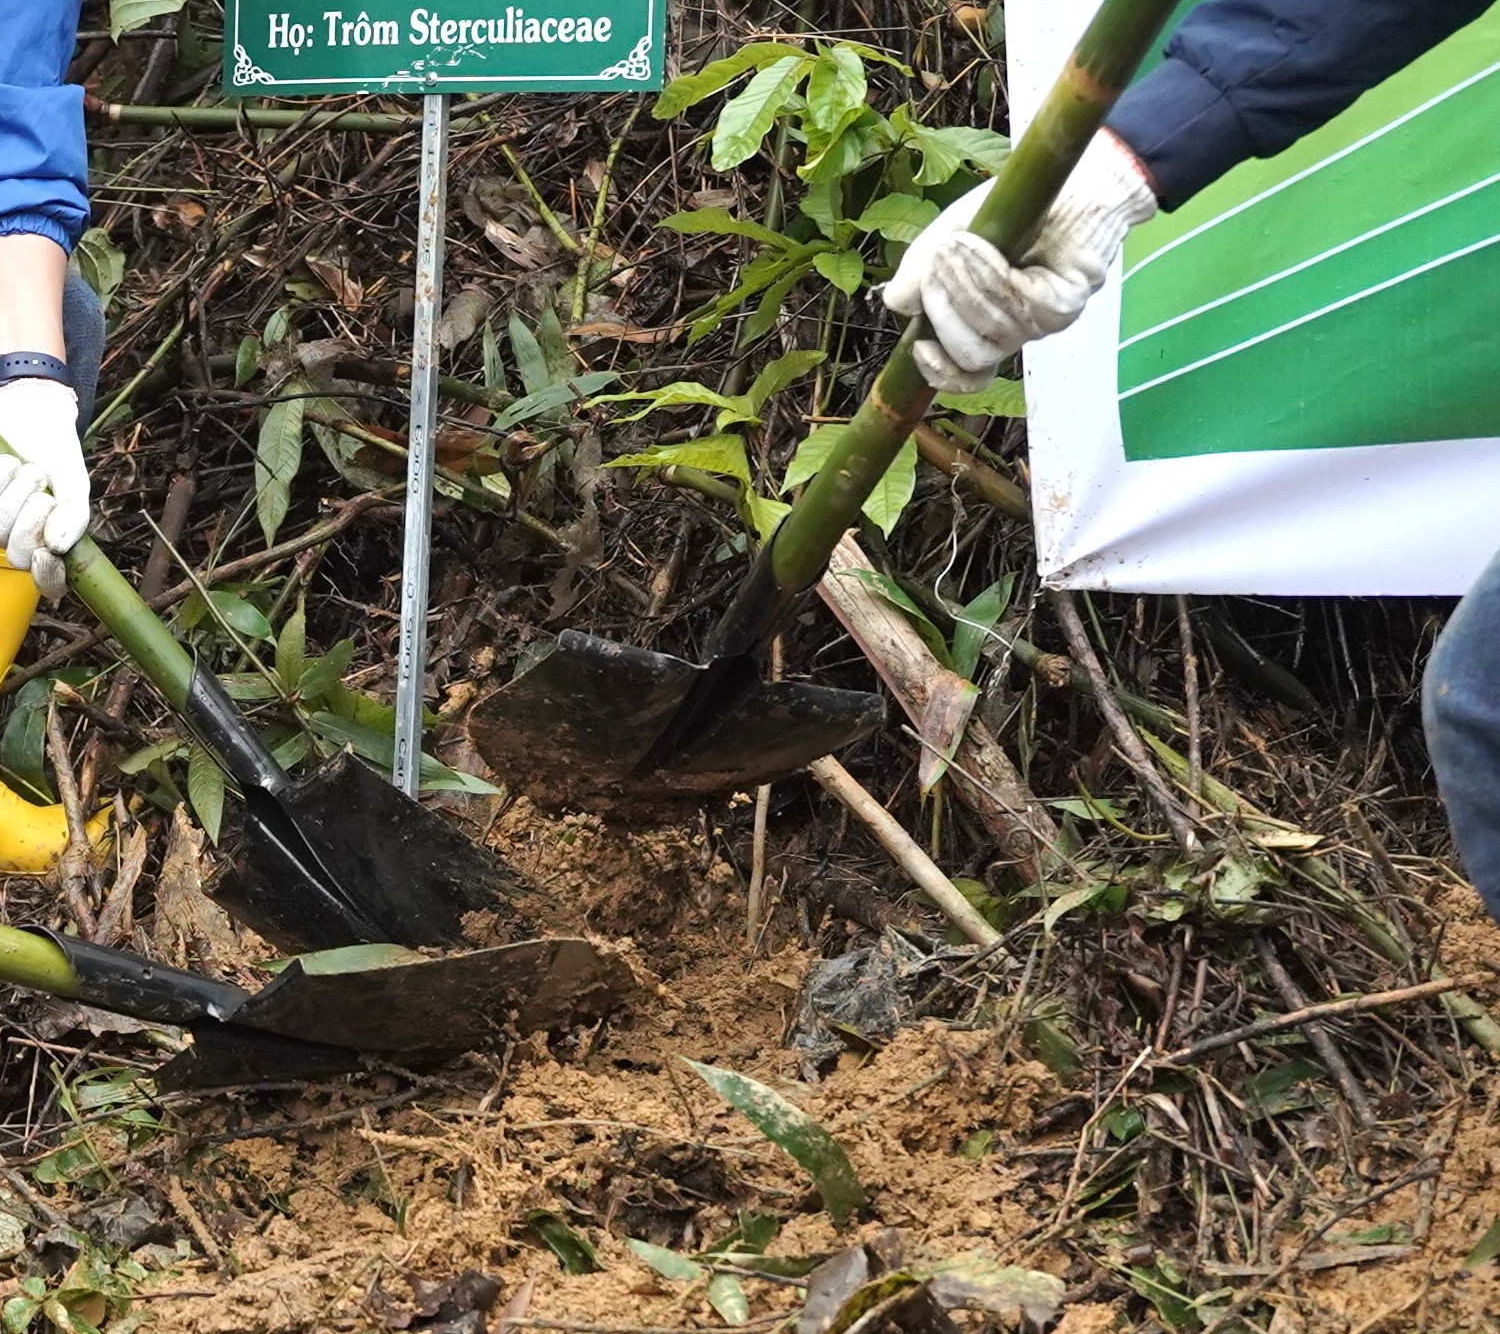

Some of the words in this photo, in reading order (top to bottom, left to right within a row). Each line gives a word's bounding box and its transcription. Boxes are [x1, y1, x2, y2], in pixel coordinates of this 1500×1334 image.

[268, 14, 314, 56] Họ:
[322, 10, 399, 47] Trôm
[409, 7, 612, 46] Sterculiaceae
